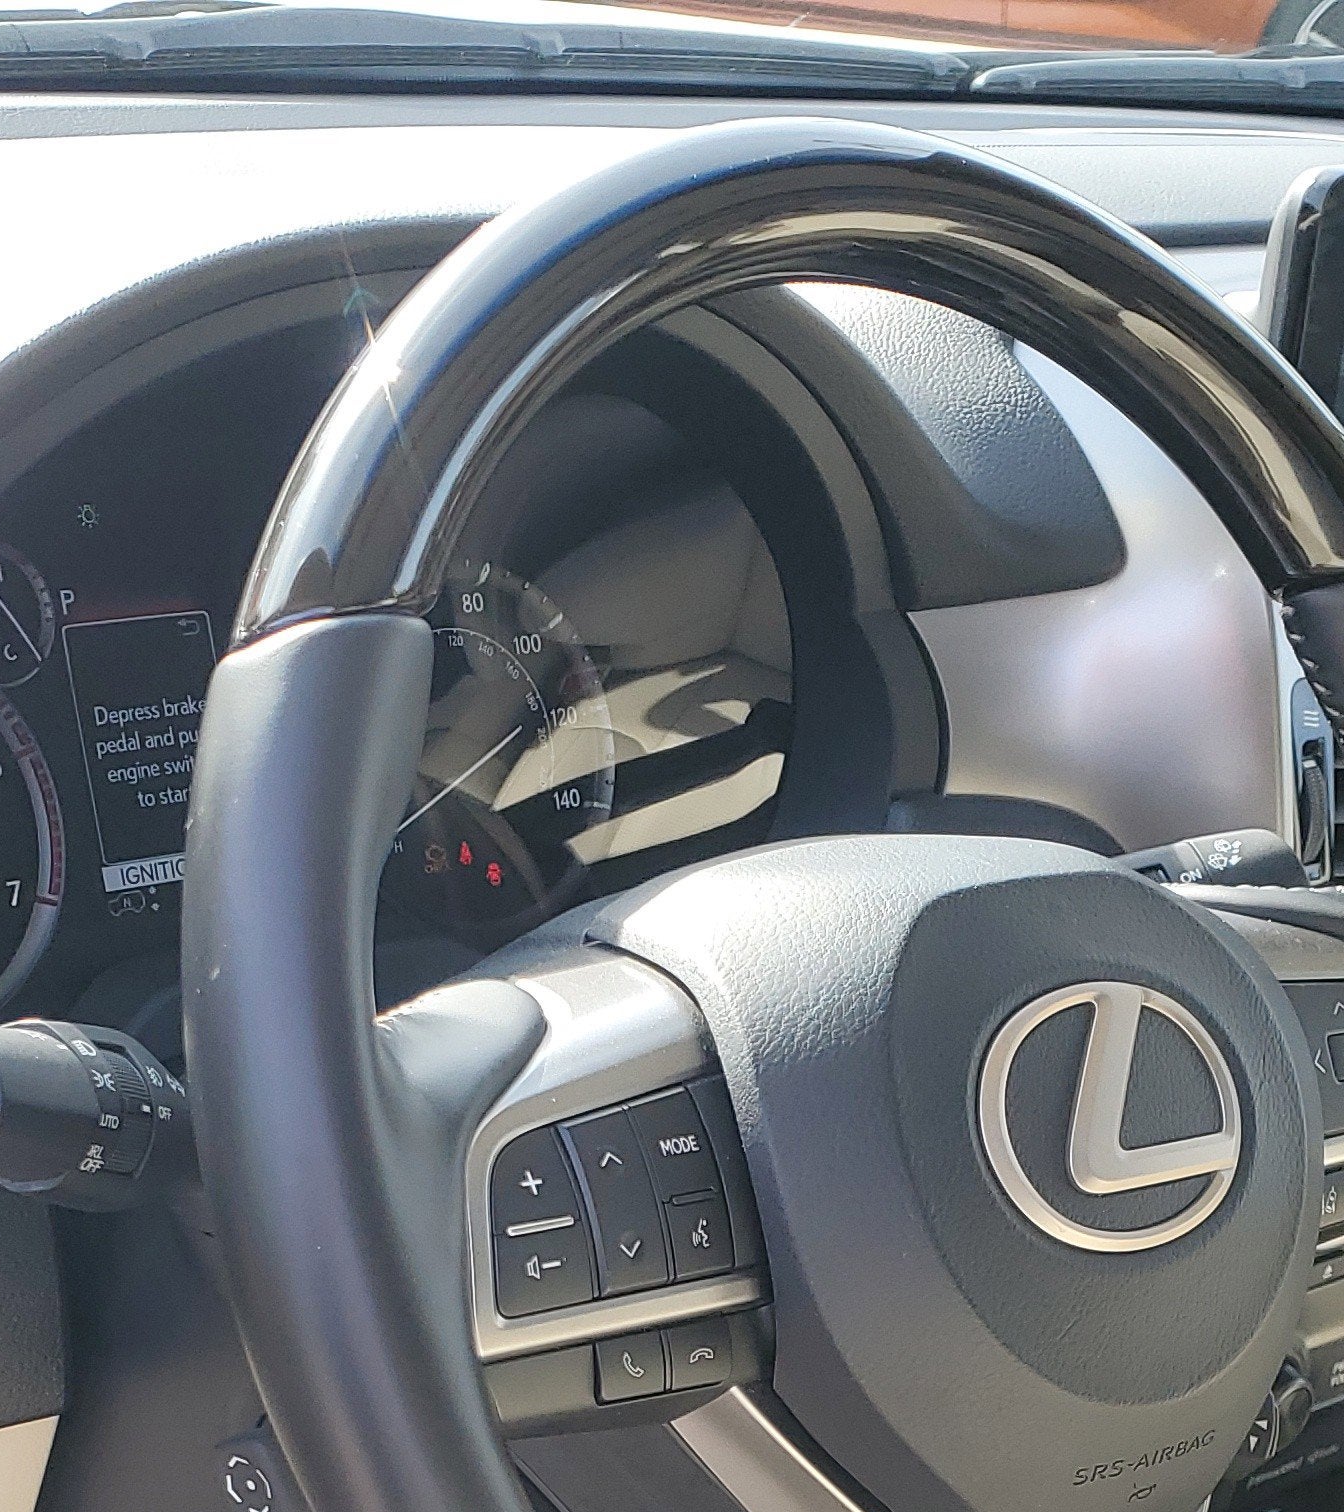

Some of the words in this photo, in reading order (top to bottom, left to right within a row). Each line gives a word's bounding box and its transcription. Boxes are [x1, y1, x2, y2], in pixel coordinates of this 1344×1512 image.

[60, 589, 75, 615] P
[462, 592, 484, 613] 80
[4, 644, 18, 661] C
[448, 635, 464, 647] 120
[513, 633, 542, 655] 100
[93, 704, 161, 728] Depress
[162, 694, 207, 718] brake
[550, 705, 577, 728] 120
[96, 730, 141, 760] pedal
[145, 726, 175, 750] and
[178, 728, 200, 749] pu
[107, 760, 161, 785] engine
[163, 753, 195, 775] swit
[137, 791, 156, 808] to
[159, 785, 190, 805] star
[553, 788, 581, 811] 140
[120, 857, 187, 886] IGNITIO
[1180, 867, 1203, 884] ON
[5, 879, 21, 907] 7
[98, 1113, 120, 1130] UTO
[660, 1134, 700, 1157] MODE
[1073, 1429, 1216, 1486] SRS-AIRBAG
